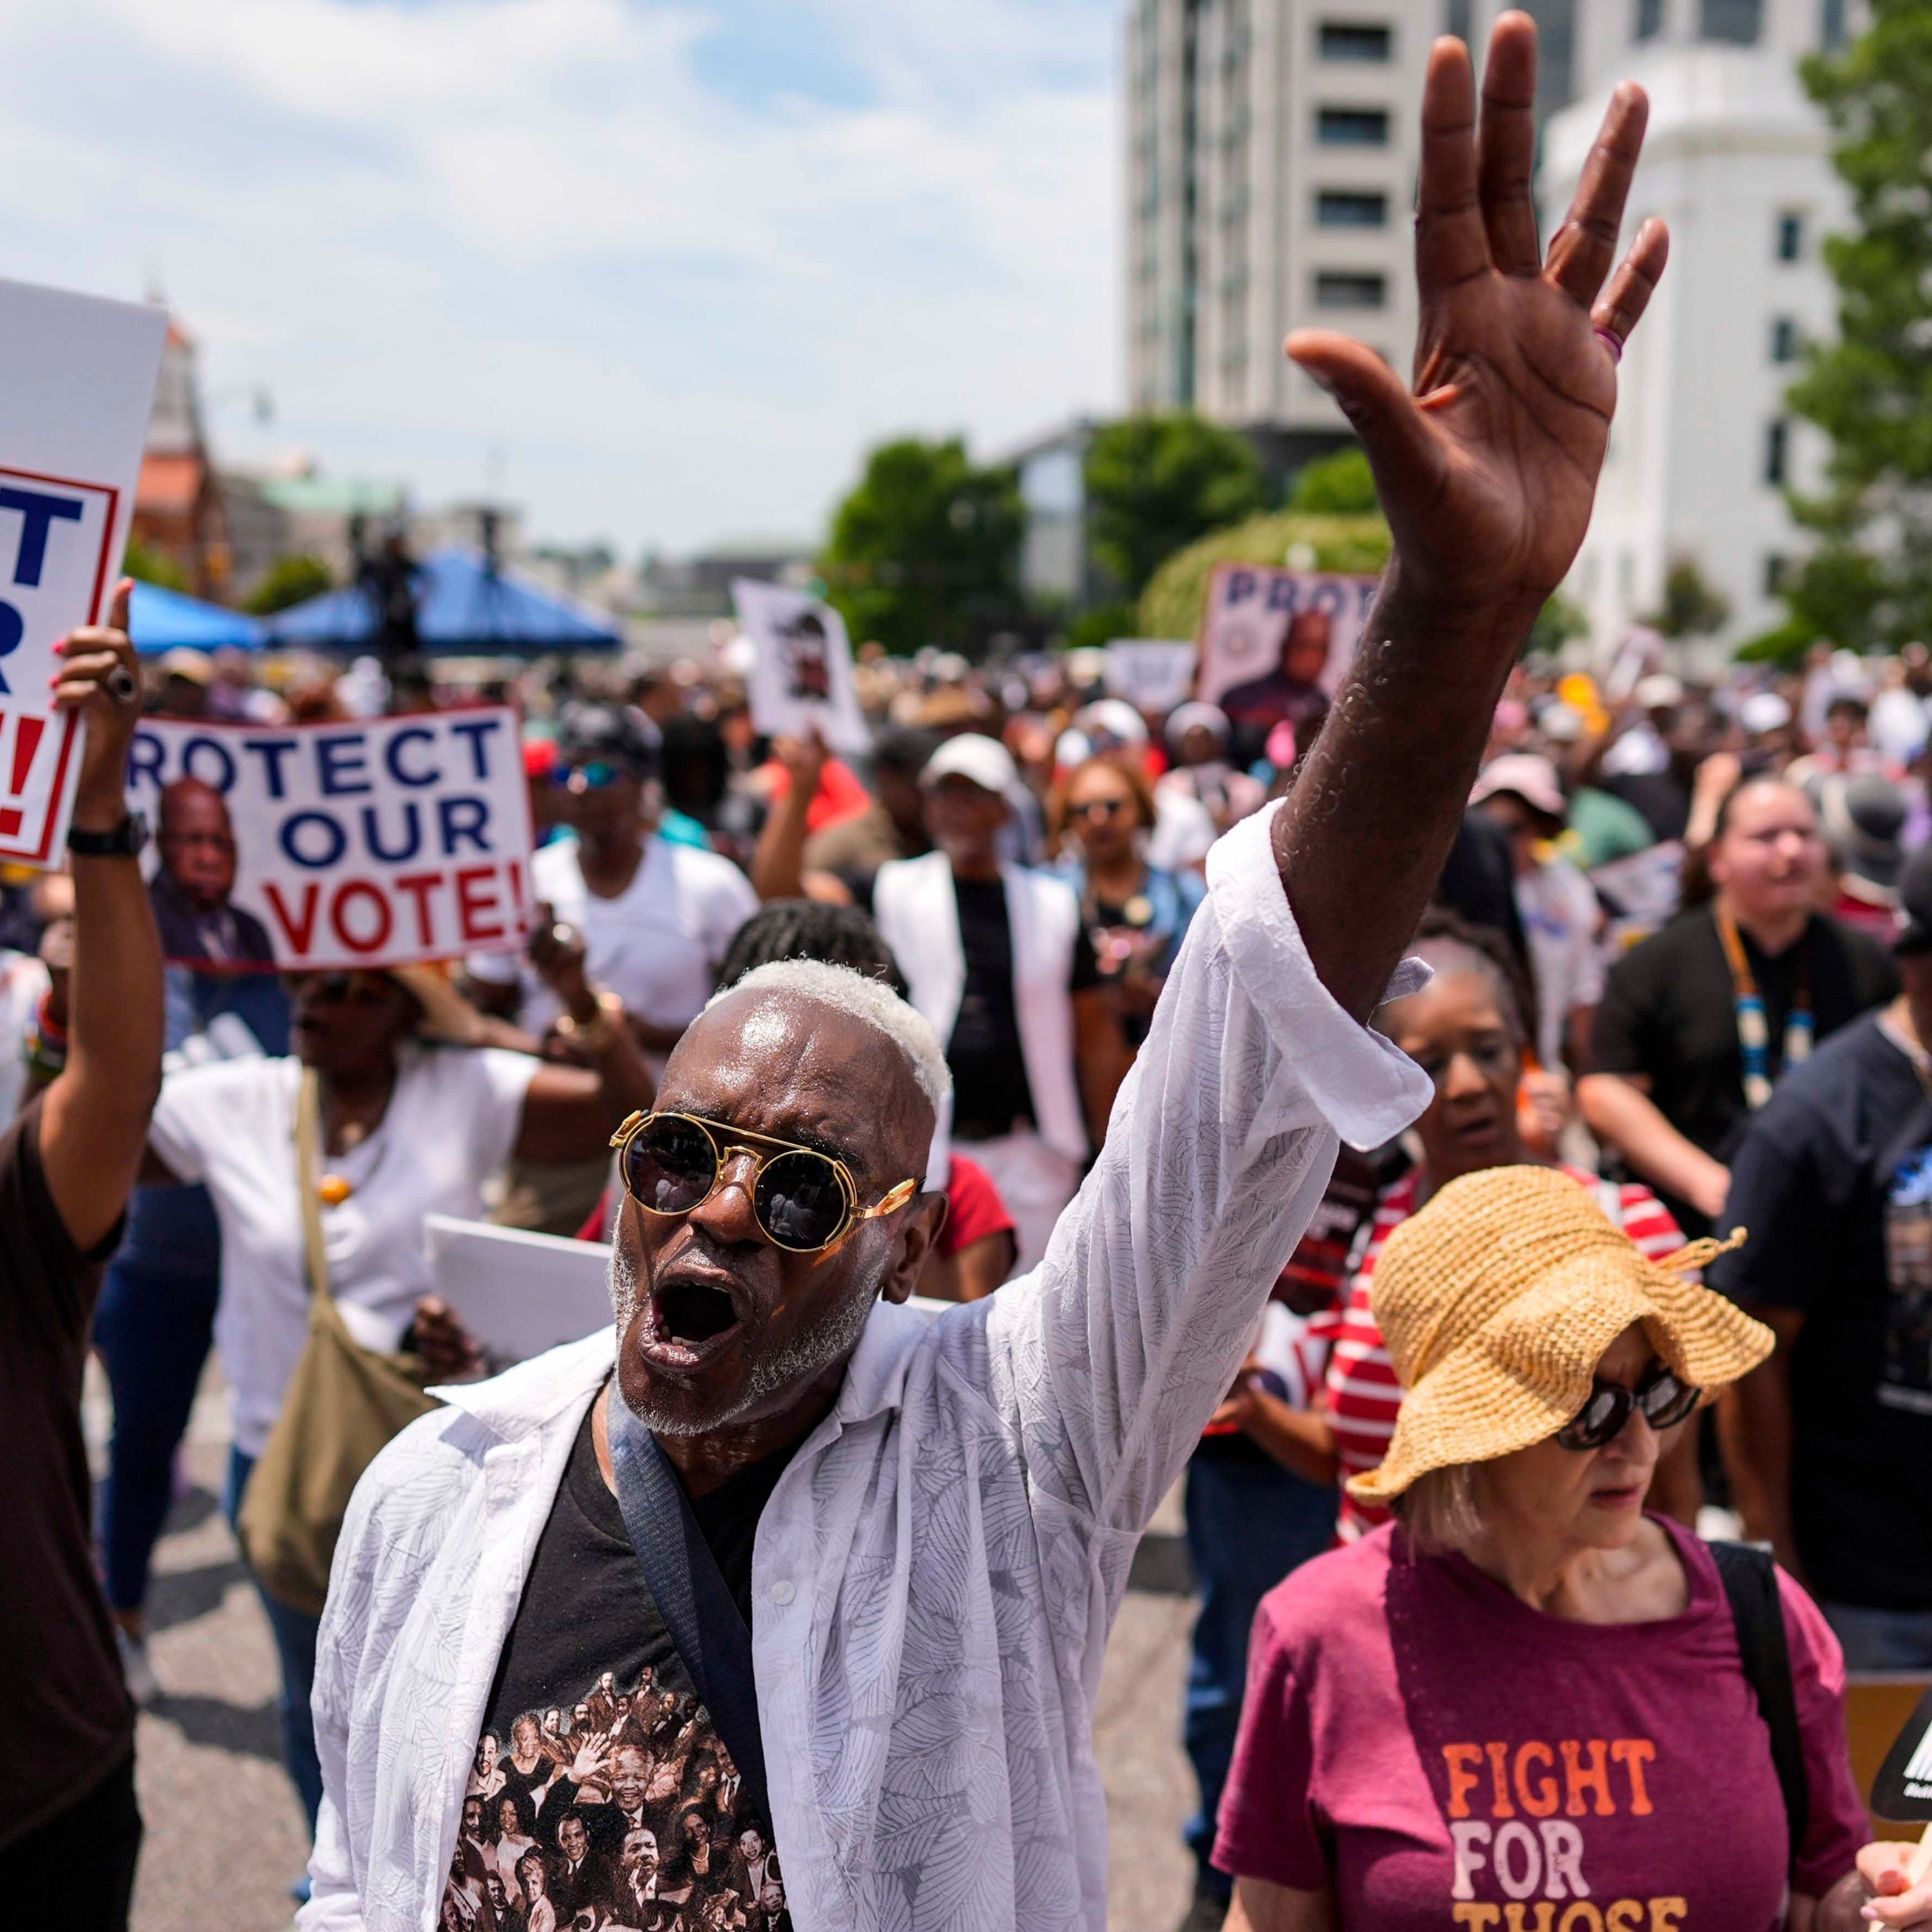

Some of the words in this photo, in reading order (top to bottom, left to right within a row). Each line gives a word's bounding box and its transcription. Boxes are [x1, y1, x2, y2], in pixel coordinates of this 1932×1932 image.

[127, 719, 500, 799] ROTECT
[279, 798, 493, 867] OUR
[265, 861, 528, 954] VOTE!
[1442, 1739, 1656, 1818] FIGHT
[1450, 1819, 1591, 1899] FOR
